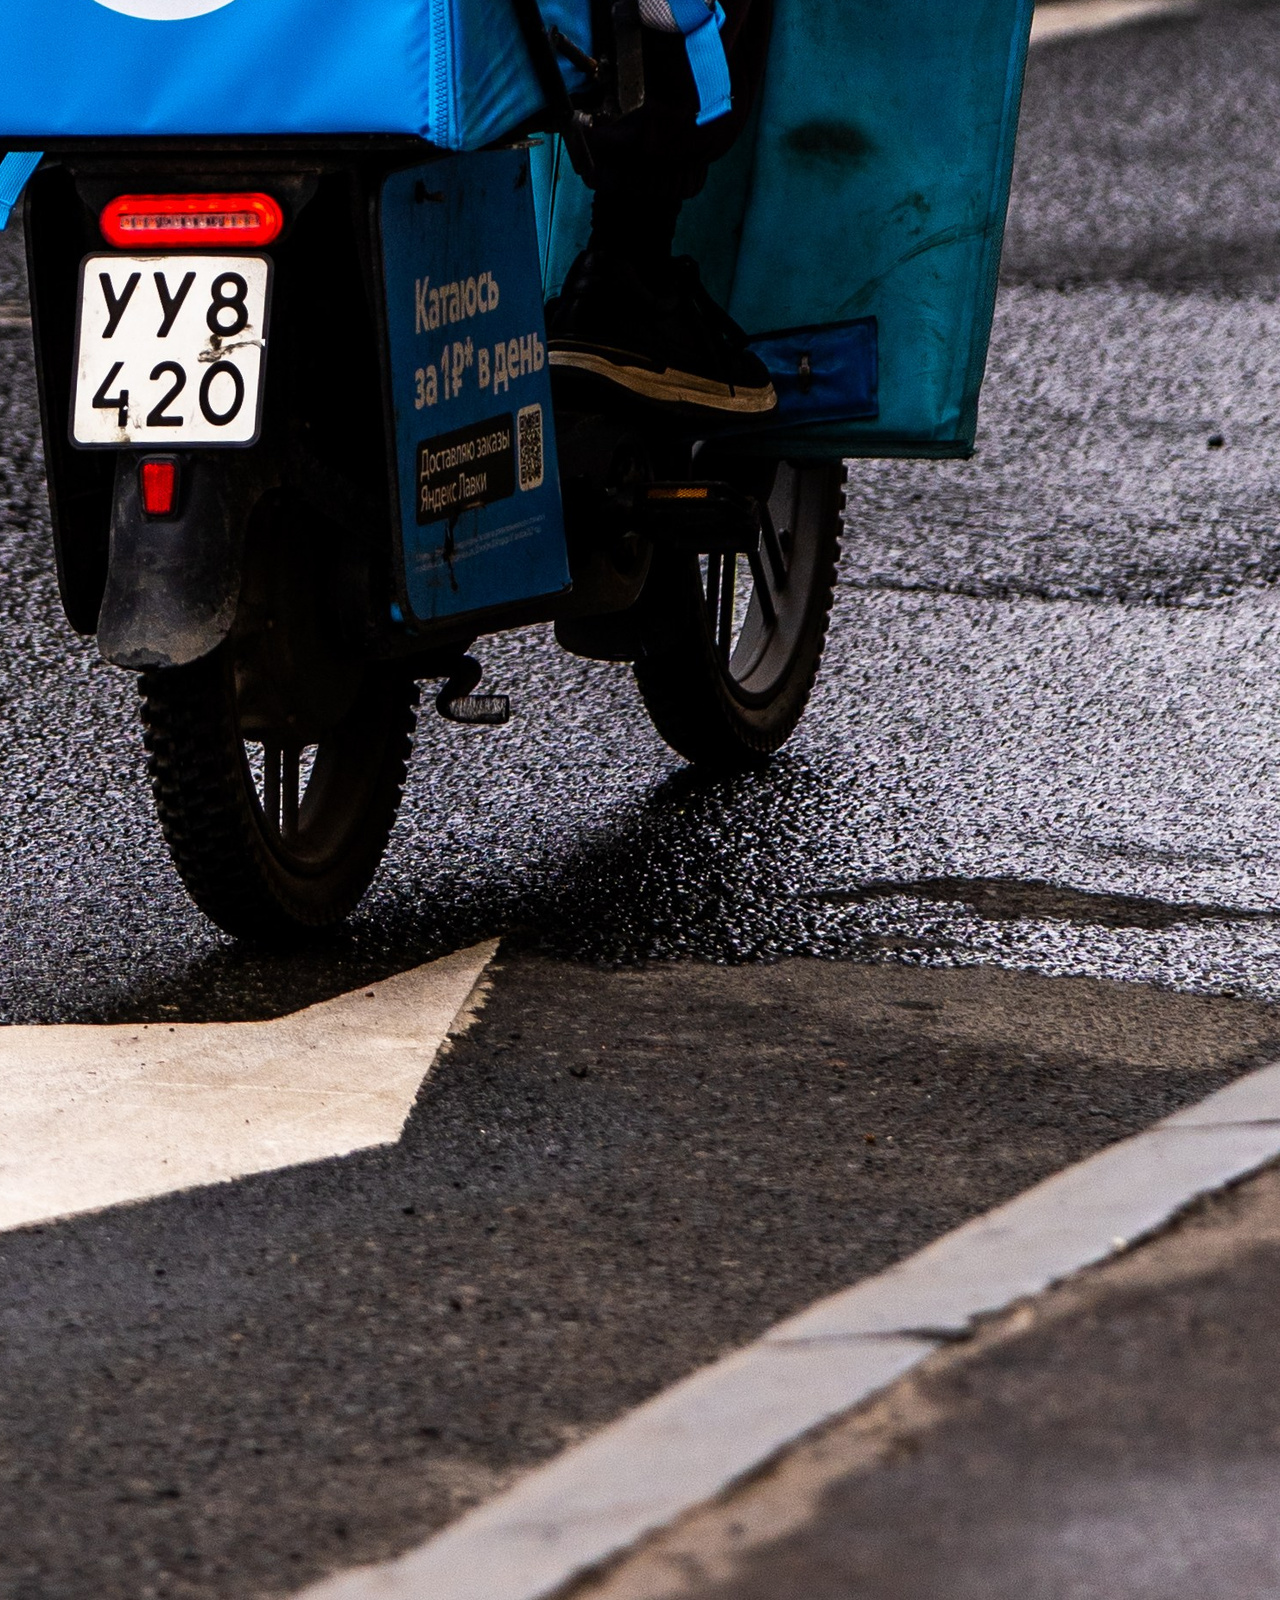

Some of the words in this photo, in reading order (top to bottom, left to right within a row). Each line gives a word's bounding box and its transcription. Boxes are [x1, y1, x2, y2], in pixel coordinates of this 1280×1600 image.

[414, 270, 500, 335] Катаюсь
[91, 360, 245, 427] 420
[414, 364, 438, 410] за
[478, 348, 490, 389] в
[493, 331, 545, 395] день
[420, 440, 476, 482] Доставляю
[476, 428, 510, 458] заказы
[420, 484, 458, 513] Яндекс
[458, 472, 487, 500] Лавки
